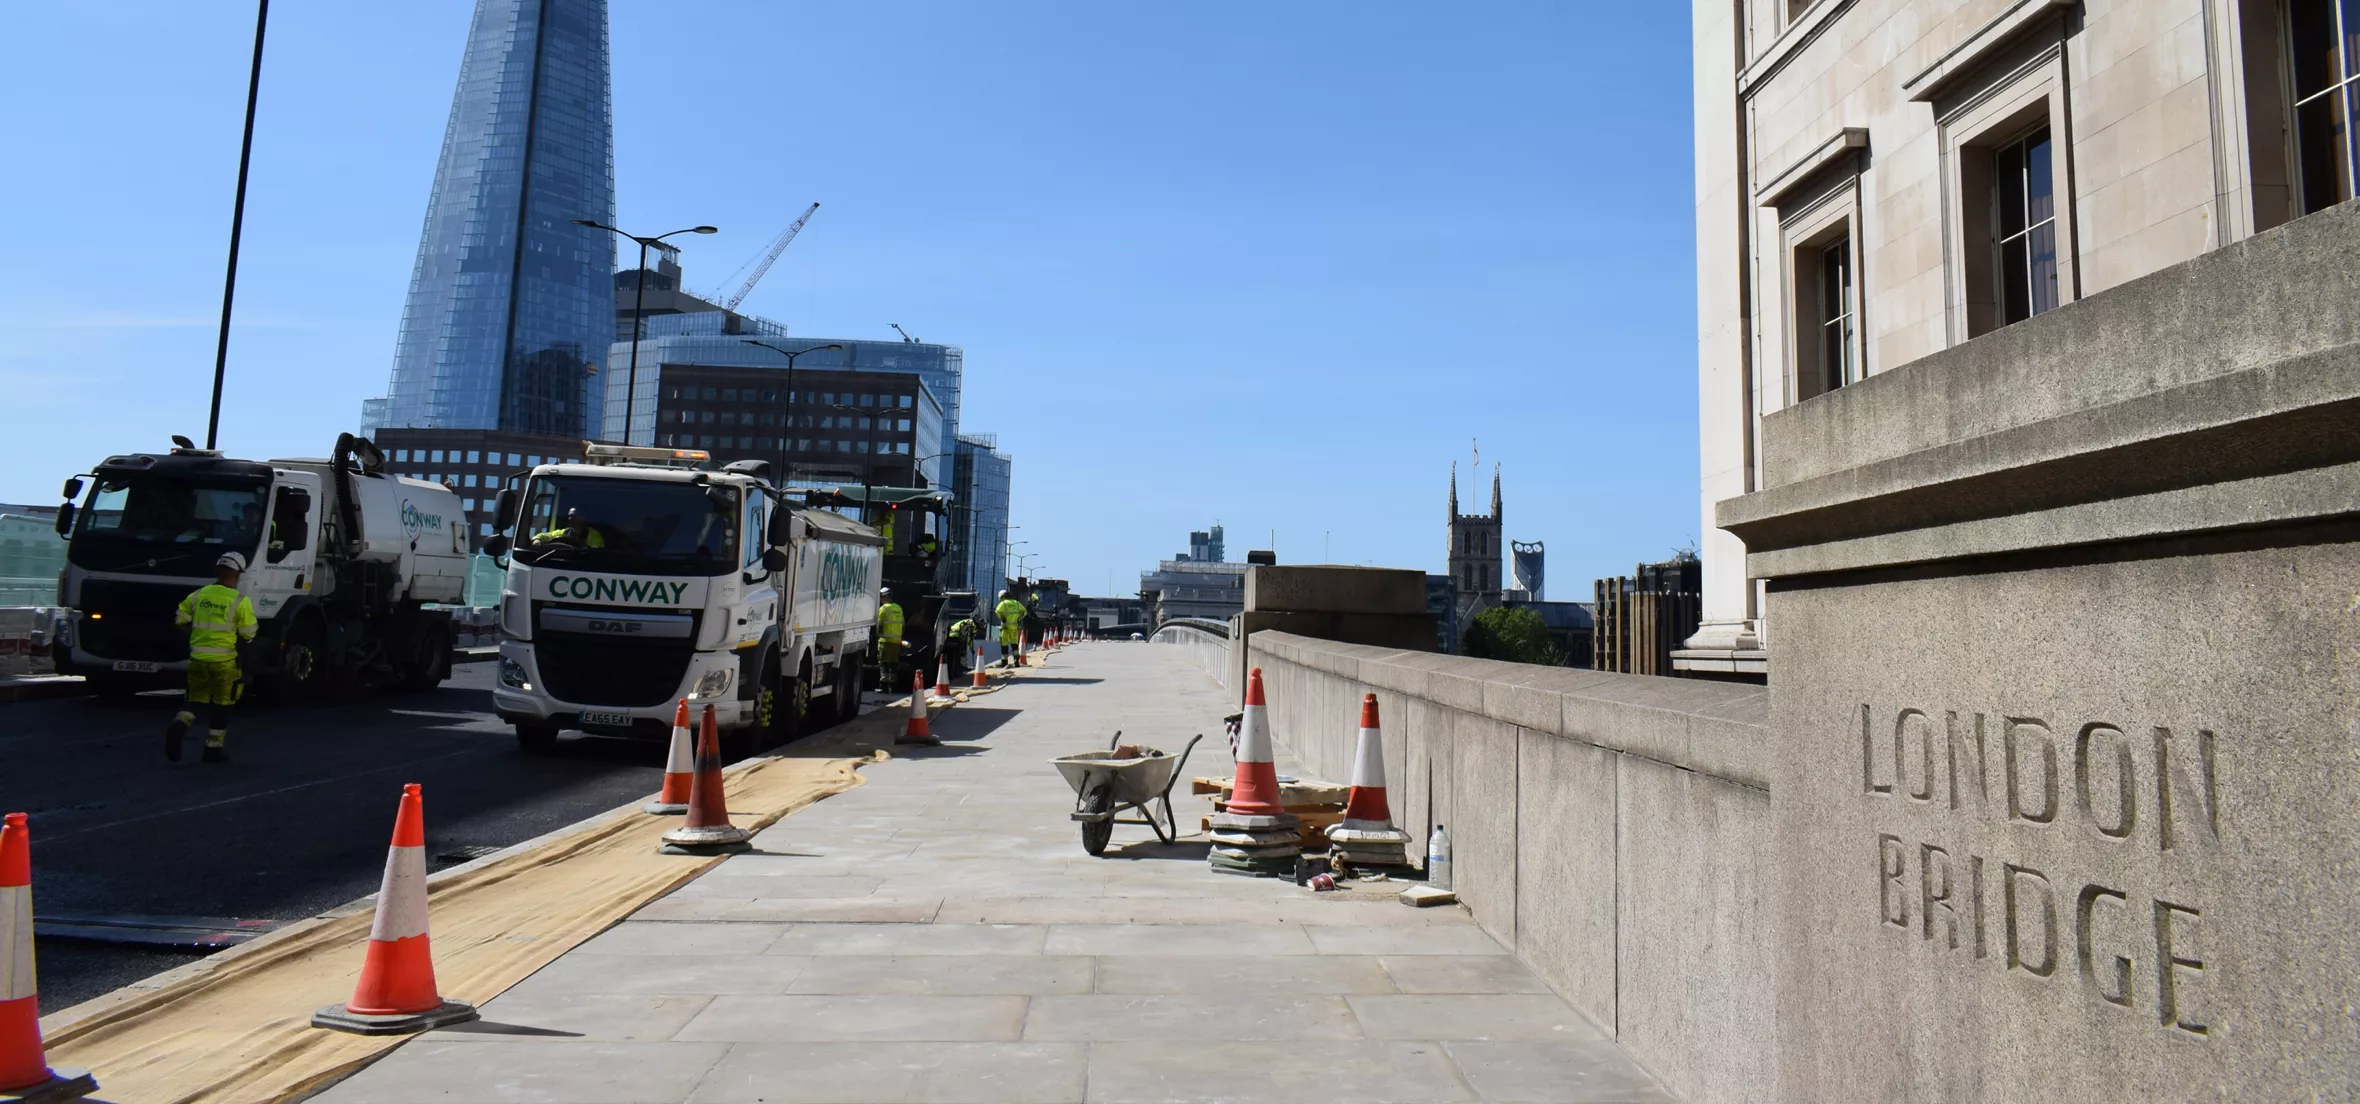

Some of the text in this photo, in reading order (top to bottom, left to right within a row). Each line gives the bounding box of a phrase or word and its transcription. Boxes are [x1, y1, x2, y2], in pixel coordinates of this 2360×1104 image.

[401, 499, 442, 530] CONWAY
[548, 575, 689, 605] CONWAY
[822, 552, 870, 600] CONWAY
[588, 620, 643, 633] DAF
[584, 712, 632, 726] EA65 EAY
[1861, 702, 2220, 852] LONDON
[1878, 832, 2208, 1037] BRIDGE
